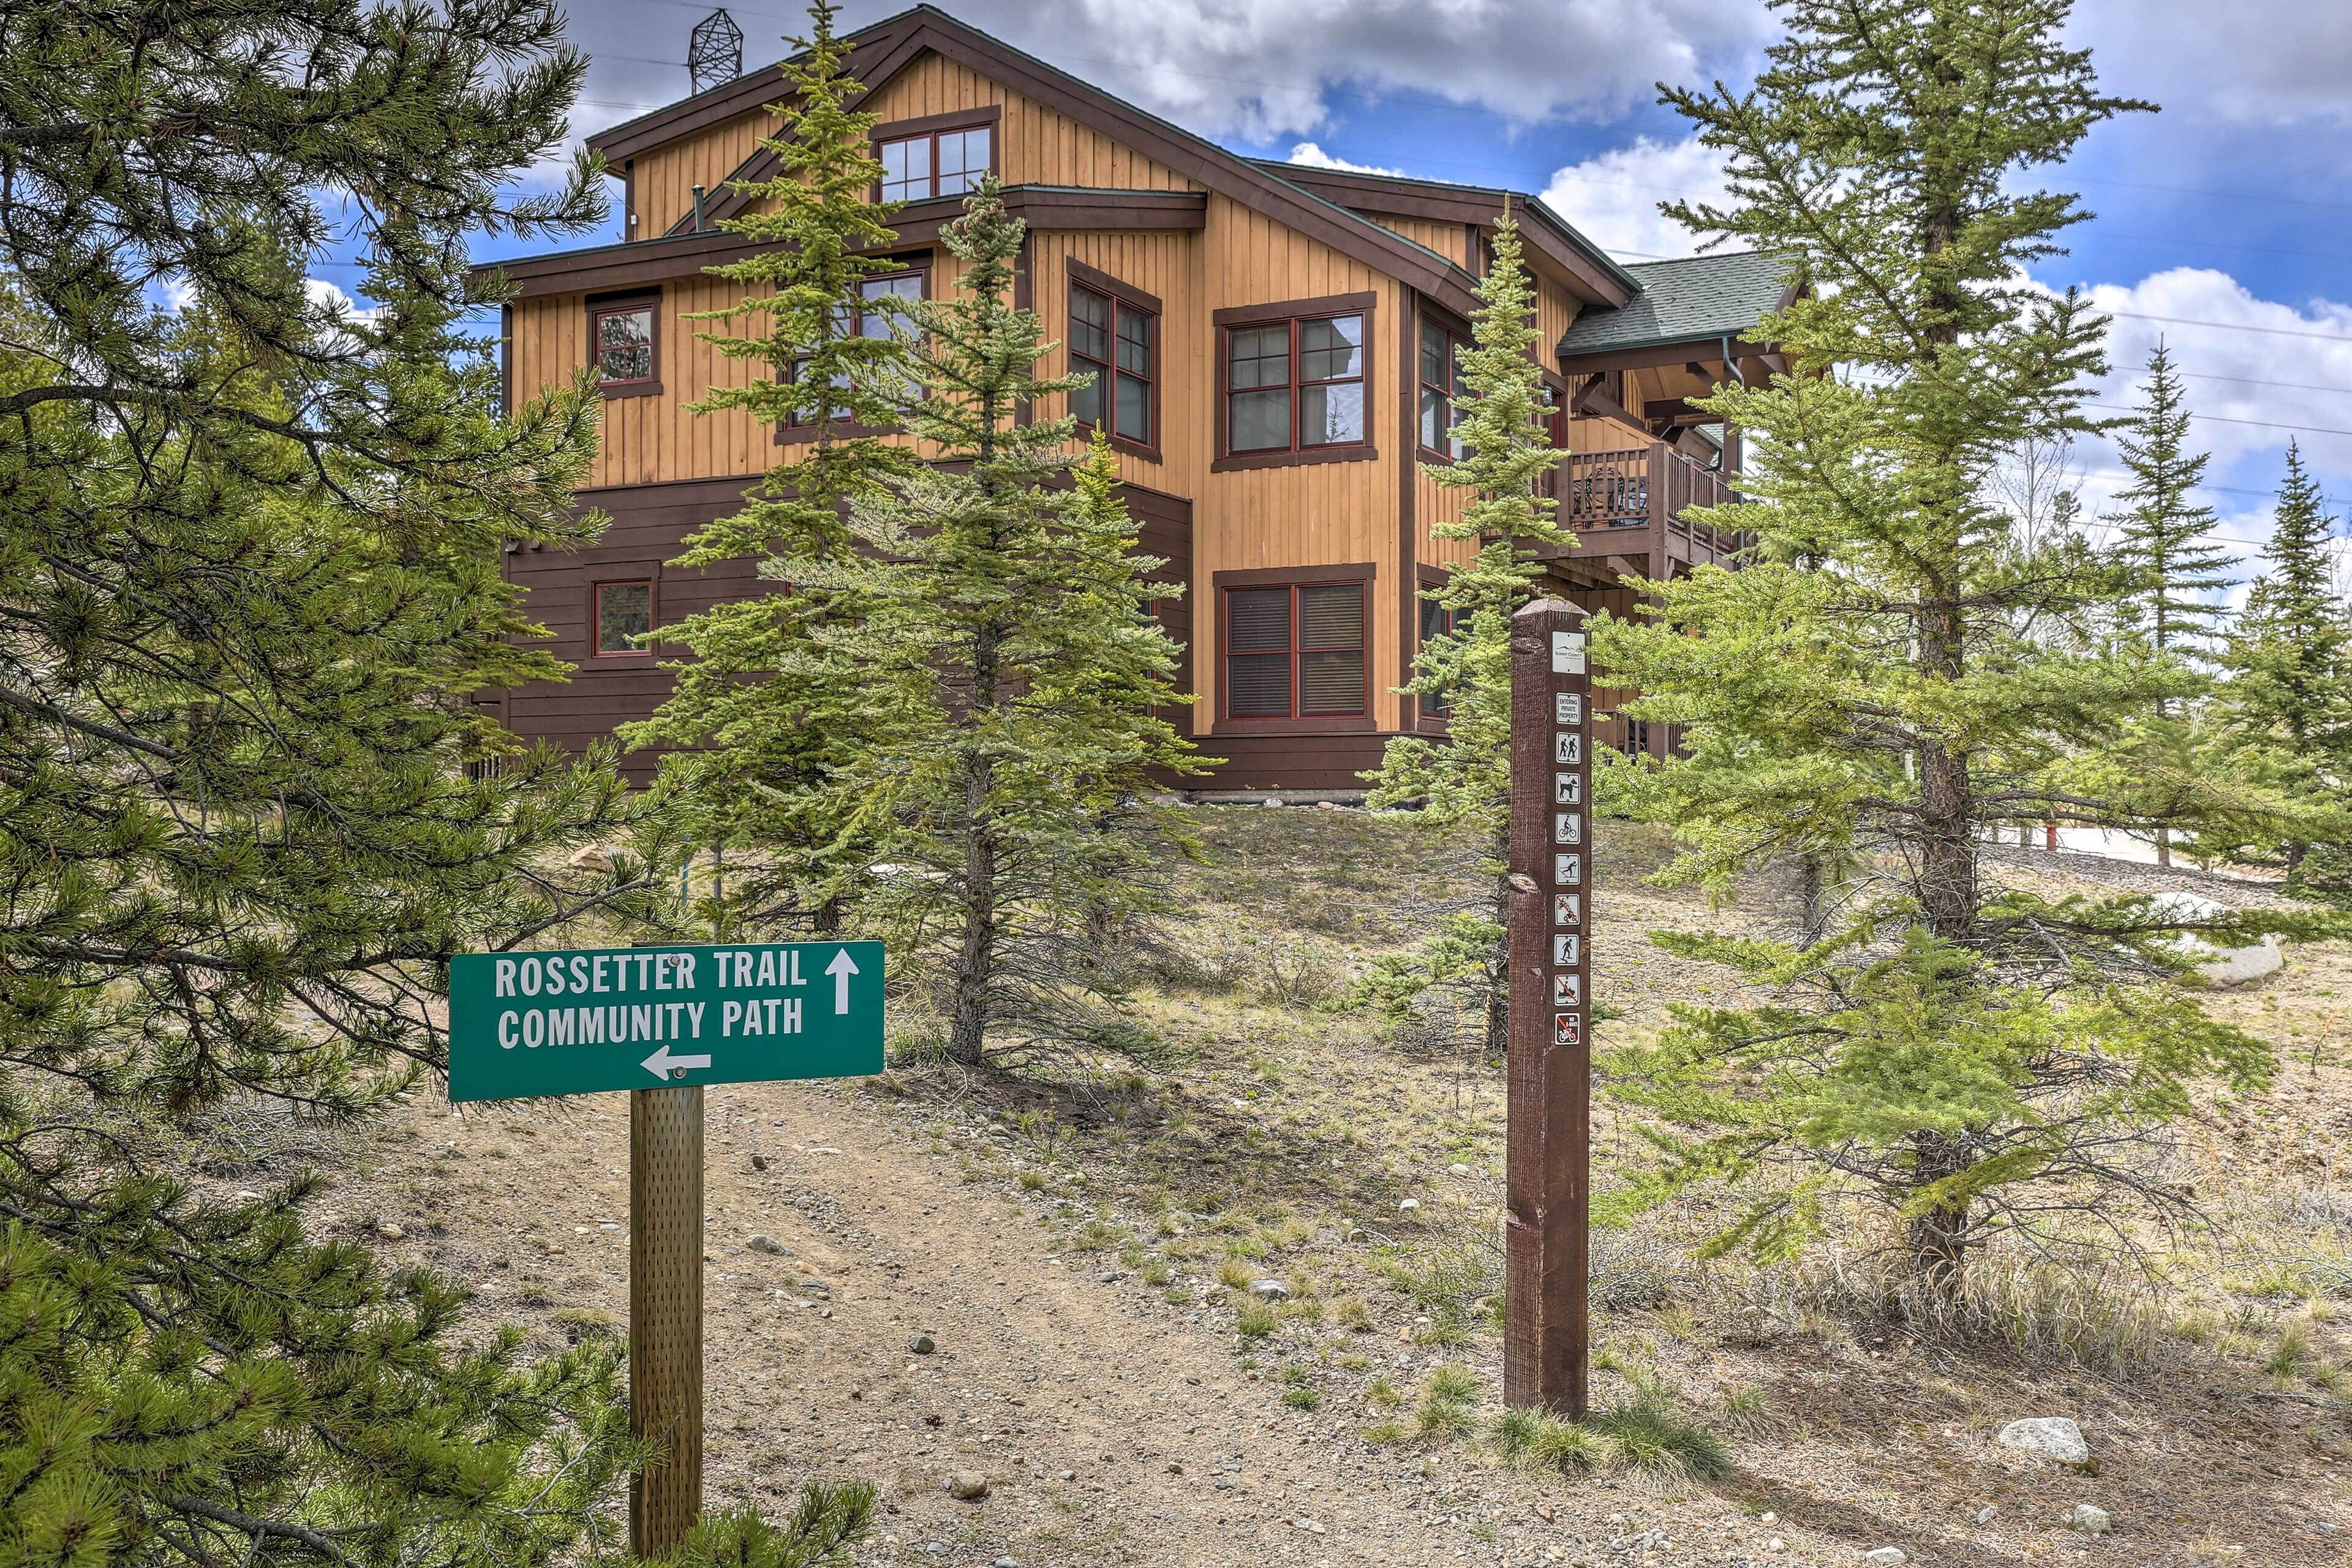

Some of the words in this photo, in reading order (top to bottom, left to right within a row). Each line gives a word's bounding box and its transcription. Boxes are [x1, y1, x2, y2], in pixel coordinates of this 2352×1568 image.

[495, 952, 696, 997] ROSSETTER
[714, 950, 807, 988] TRAIL
[498, 1001, 706, 1050] COMMUNITY
[723, 998, 802, 1036] PATH
